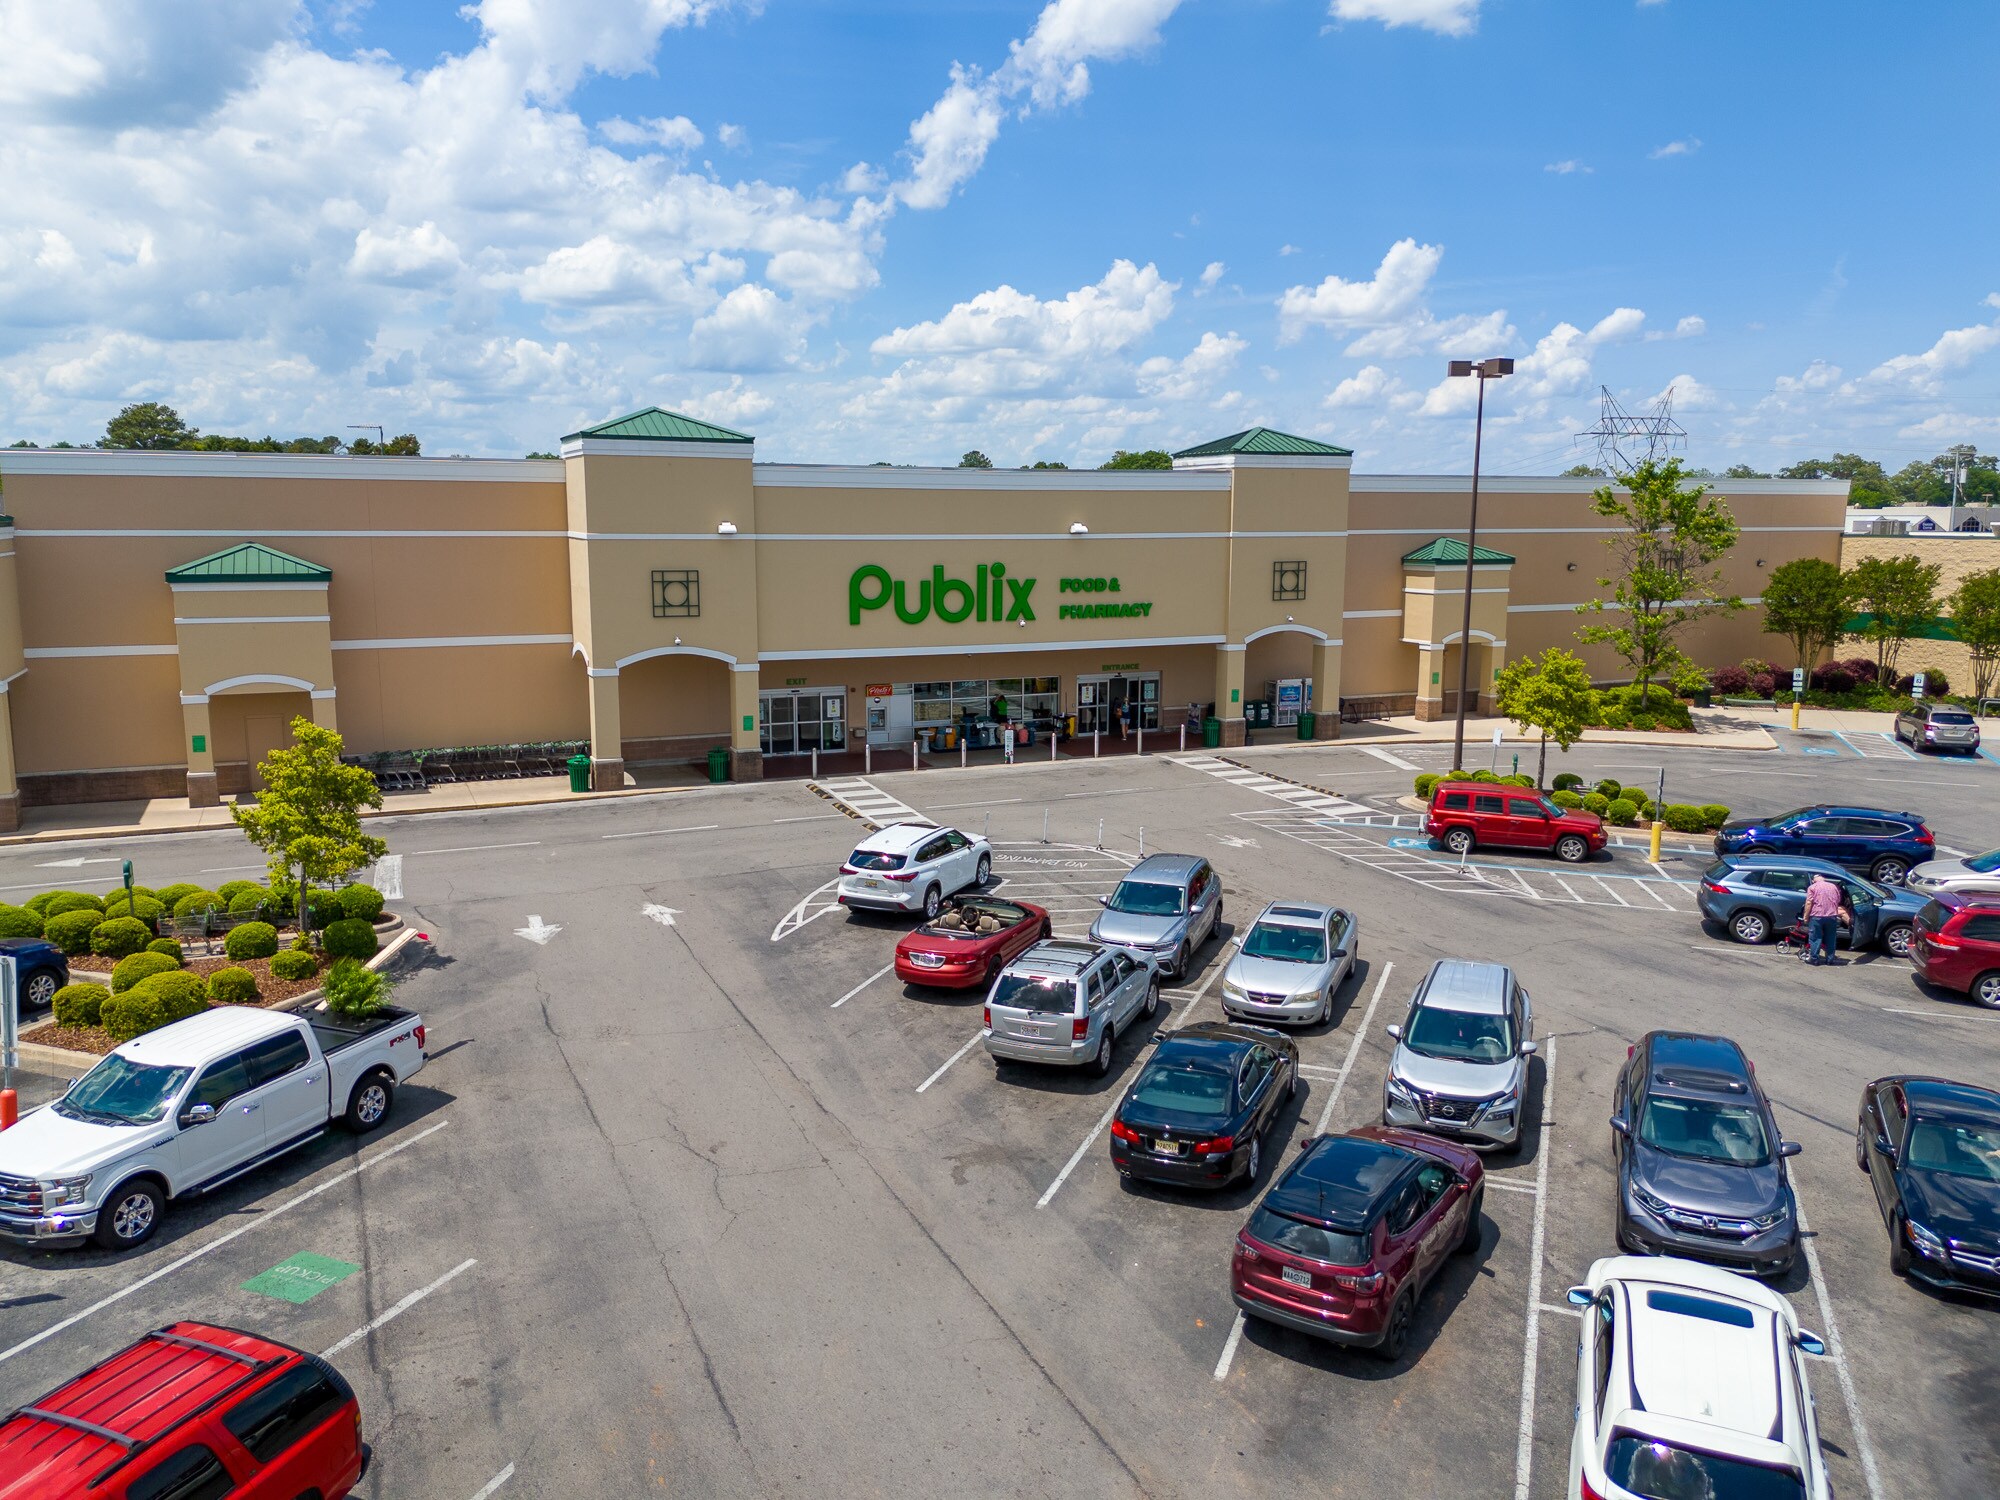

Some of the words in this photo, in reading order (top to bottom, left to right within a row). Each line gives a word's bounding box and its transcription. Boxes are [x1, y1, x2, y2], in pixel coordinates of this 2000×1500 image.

[1060, 577, 1104, 593] FOOD
[1108, 577, 1121, 592] &
[849, 562, 1037, 626] Publix
[1059, 602, 1153, 620] PHARMACY
[1101, 663, 1140, 671] ENTRANCE
[786, 677, 808, 686] EXIT
[994, 853, 1060, 866] PARKING
[1064, 860, 1088, 868] NO
[275, 1265, 337, 1285] PICKUP
